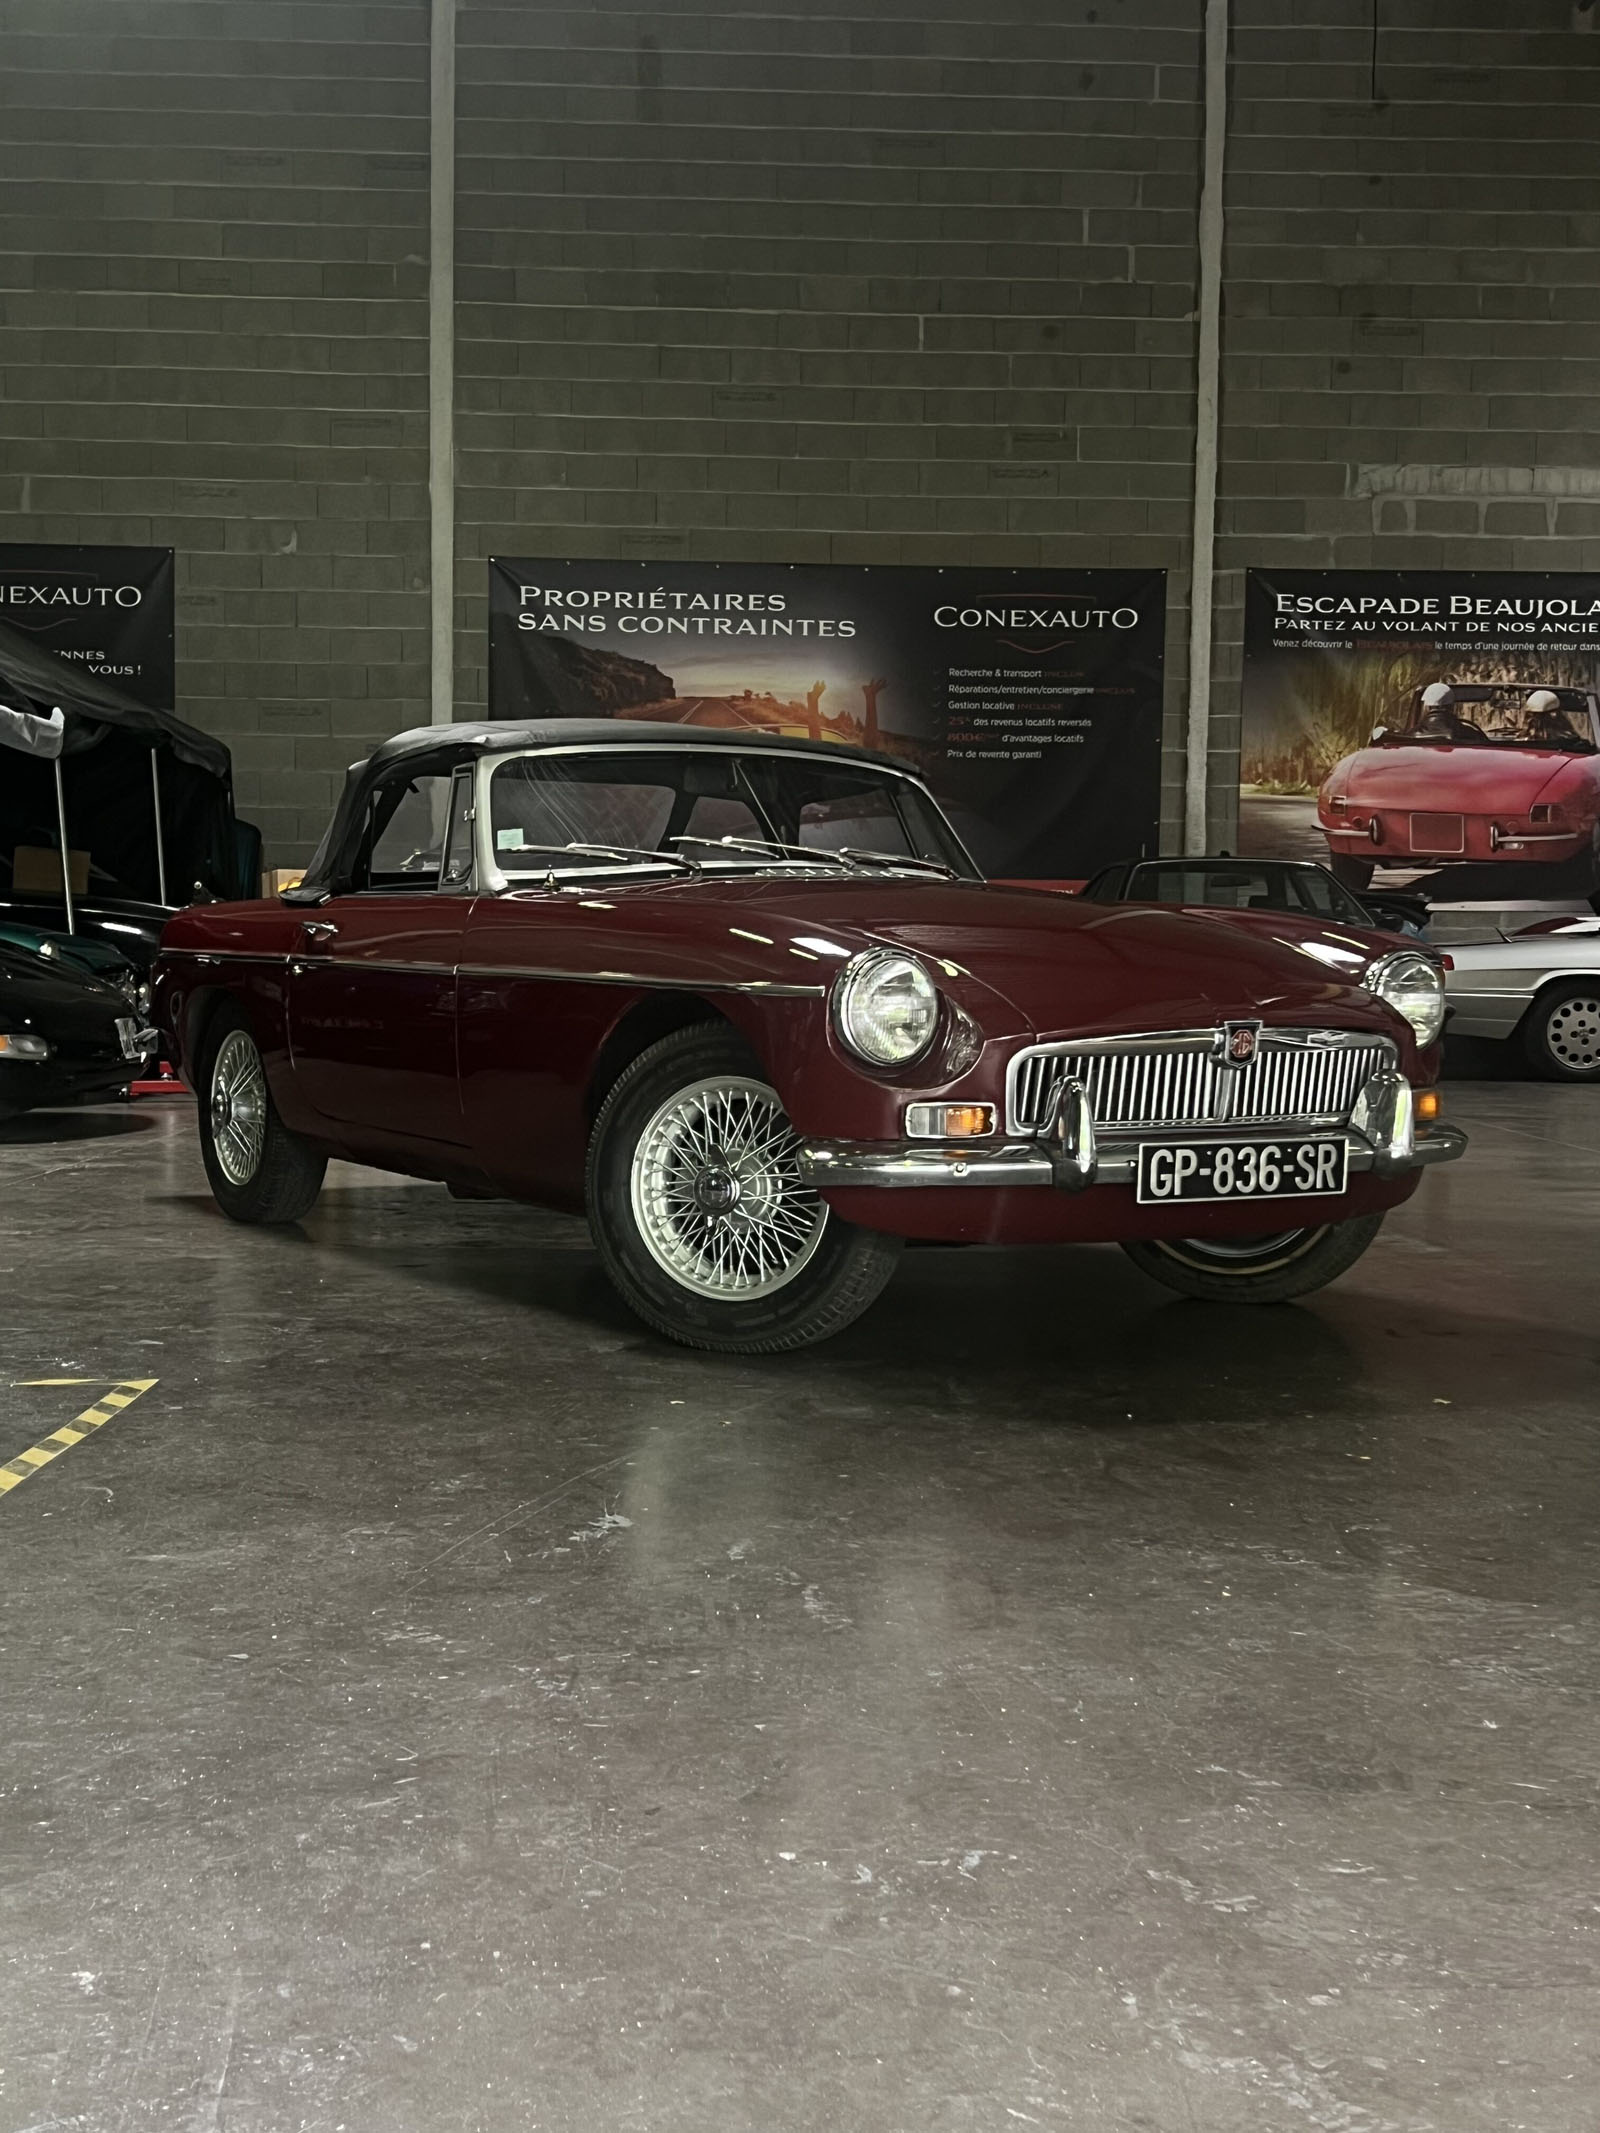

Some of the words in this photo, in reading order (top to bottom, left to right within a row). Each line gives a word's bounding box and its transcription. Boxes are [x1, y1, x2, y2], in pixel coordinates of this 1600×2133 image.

[520, 586, 786, 612] PROPRIÉTAIRES
[1277, 594, 1439, 614] ESCAPADE
[934, 607, 1138, 628] CONEXAUTO
[519, 613, 606, 631] SANS
[618, 616, 855, 637] CONTRAINTES
[1275, 618, 1345, 630] PARTEZ
[1352, 621, 1375, 630] AU
[1383, 622, 1459, 631] VOLANT
[1467, 622, 1489, 631] DE
[1498, 623, 1535, 632] NOS
[1541, 623, 1598, 632] ANCIE
[1273, 639, 1299, 647] Venez
[1302, 640, 1342, 648] découvrir
[1435, 641, 1442, 649] le
[1445, 642, 1472, 652] temps
[1475, 642, 1499, 650] d'une
[1501, 643, 1535, 652] journée
[89, 665, 133, 674] VOUS
[949, 668, 992, 677] Recherche
[1004, 670, 1042, 679] transport
[948, 701, 980, 709] Gestion
[982, 702, 1014, 710] locative
[1025, 718, 1055, 726] locatifs
[1002, 735, 1052, 743] d'avantages
[1012, 751, 1042, 760] garanti
[1150, 1144, 1338, 1197] GP-836-SR
